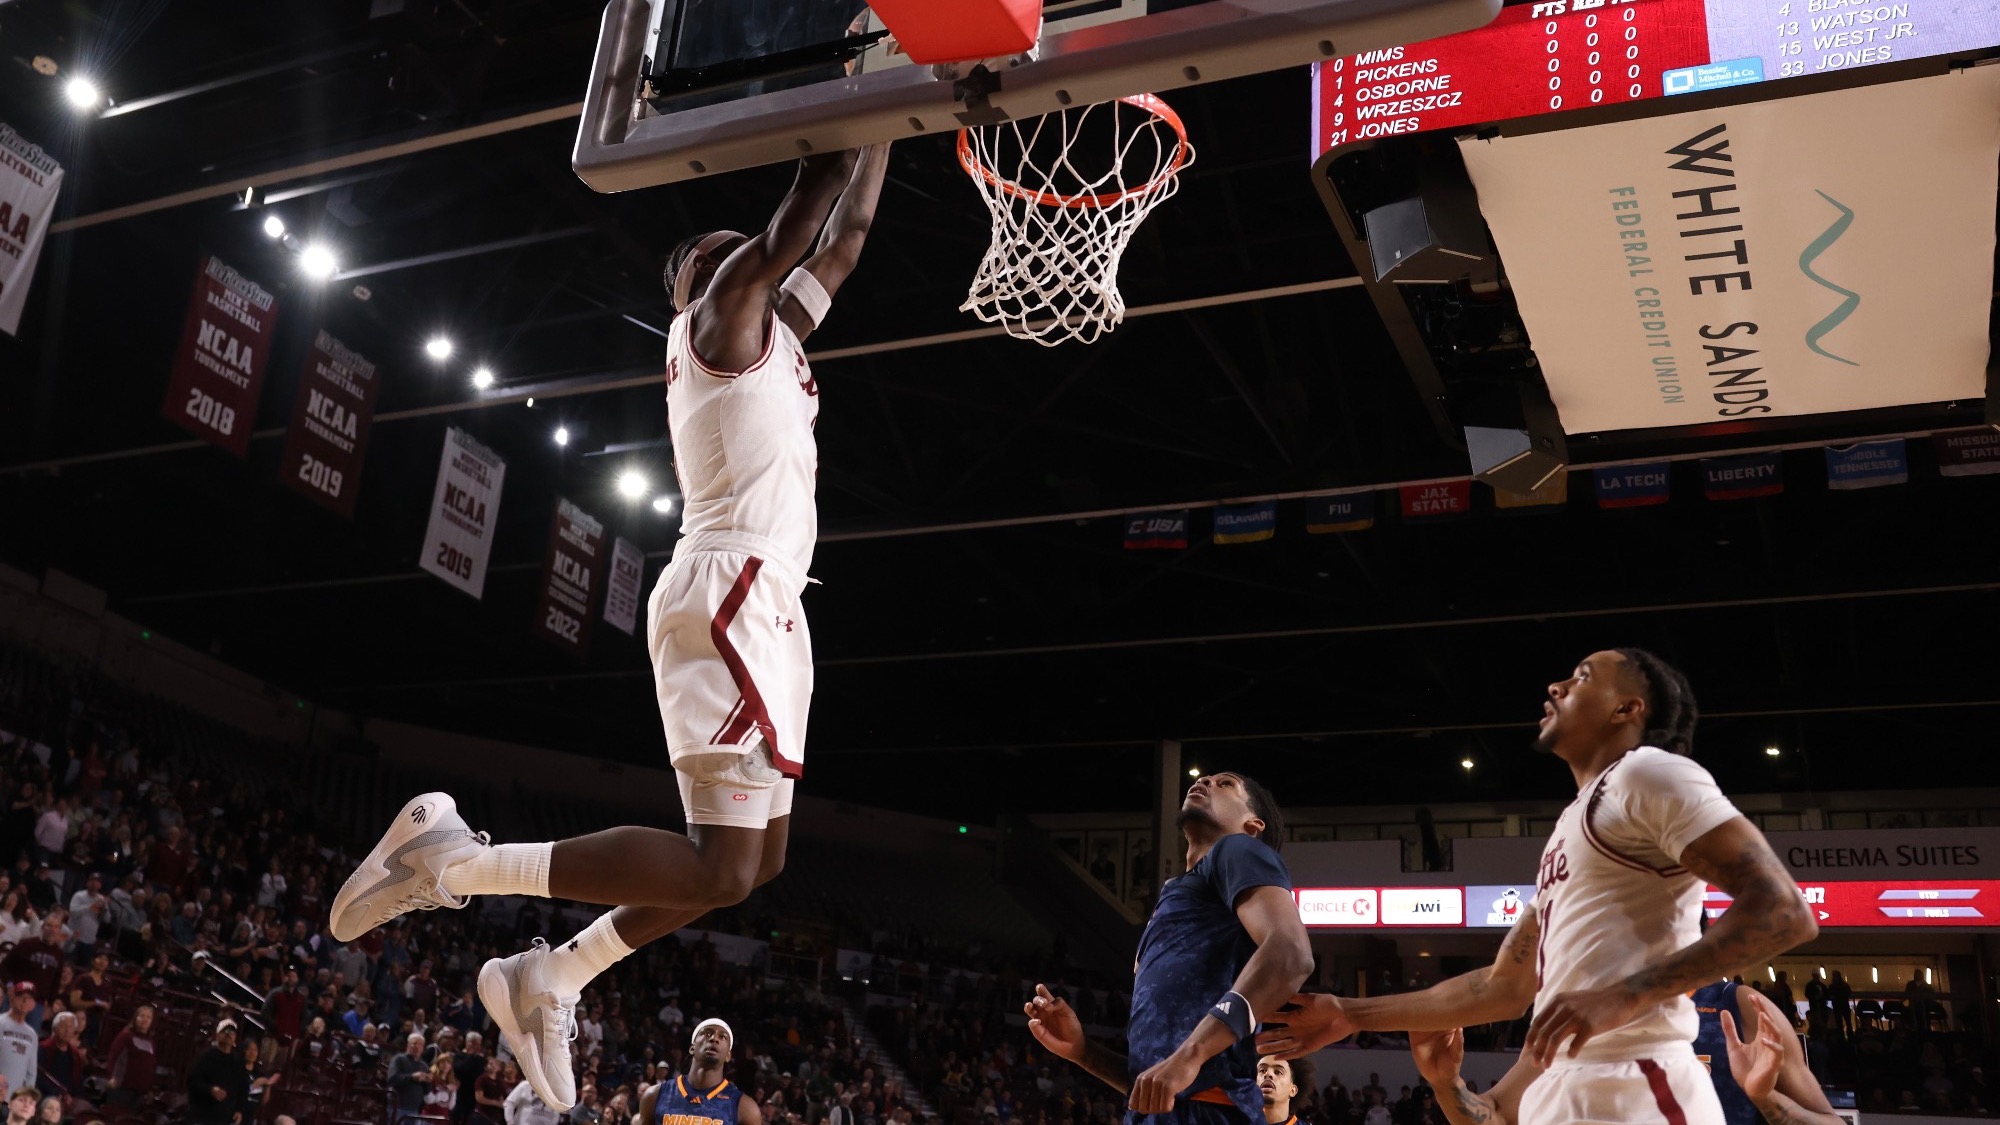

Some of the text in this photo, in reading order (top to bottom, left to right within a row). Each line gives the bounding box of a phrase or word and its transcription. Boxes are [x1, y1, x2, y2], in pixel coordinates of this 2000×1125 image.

[1531, 0, 1567, 18] PTS
[1776, 4, 1909, 37] 13 WATSON
[1779, 3, 1791, 17] 4
[1334, 8, 1635, 73] 0 MIMS 0 0 0
[1335, 26, 1637, 89] 1 PICKENS 0 0 0
[1779, 23, 1919, 57] 15 WEST JR.
[1334, 45, 1638, 107] 4 OSBORNE 0 0 0
[1780, 45, 1892, 77] 33 JONES
[1334, 64, 1640, 126] 9 WRZESZCZ 0 0 0
[1331, 83, 1642, 147] 21 JONES 0 0 0
[1664, 123, 1752, 295] WHITE
[1608, 186, 1686, 404] FEDERAL CREDIT UNION
[197, 319, 254, 375] NCAA
[1698, 321, 1772, 416] SANDS
[186, 387, 235, 436] 2018
[307, 388, 358, 440] NCAA
[299, 453, 343, 498] 2019
[1601, 473, 1665, 490] LA TECH
[1709, 463, 1775, 482] LIBERTY
[1834, 460, 1900, 474] TENNESSEE
[444, 482, 486, 527] NCAA
[1328, 503, 1352, 516] FIU
[1412, 498, 1458, 512] STATE
[1420, 486, 1449, 500] JAX
[1217, 510, 1274, 526] DELAWARE
[436, 542, 473, 580] 2019
[553, 549, 590, 591] NCAA
[545, 605, 580, 643] 2022
[1788, 845, 1980, 869] CHEEMA SUITES
[1303, 902, 1348, 913] CIRCLE
